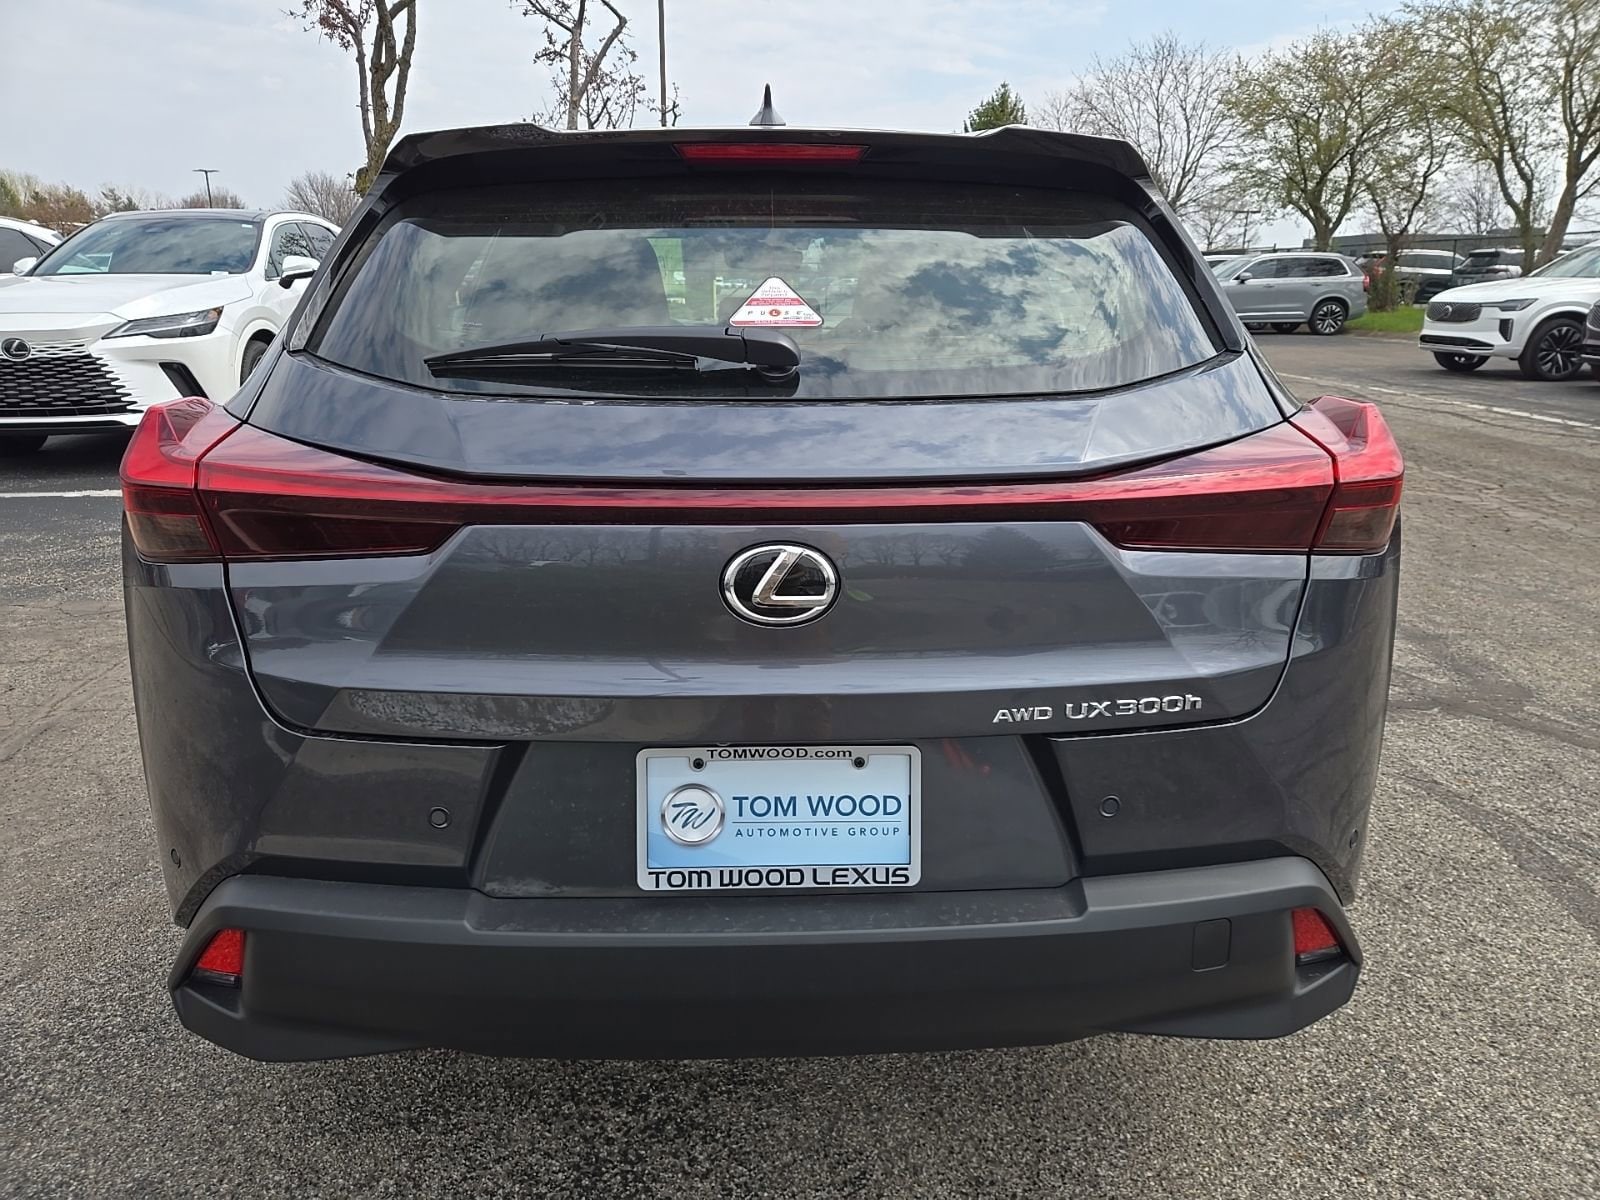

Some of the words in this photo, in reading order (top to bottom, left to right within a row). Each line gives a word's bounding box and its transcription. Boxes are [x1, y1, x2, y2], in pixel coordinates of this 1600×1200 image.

[992, 706, 1053, 723] AWD
[1065, 694, 1203, 719] UX300h
[706, 748, 853, 759] TOMWOOD.com
[671, 802, 715, 829] TW
[732, 796, 798, 817] TOM
[806, 794, 902, 817] WOOD
[735, 827, 838, 837] AUTOMOTIVE
[848, 827, 900, 836] GROUP
[648, 870, 711, 888] TOM
[719, 869, 805, 887] WOOD
[811, 866, 910, 885] LEXUS
